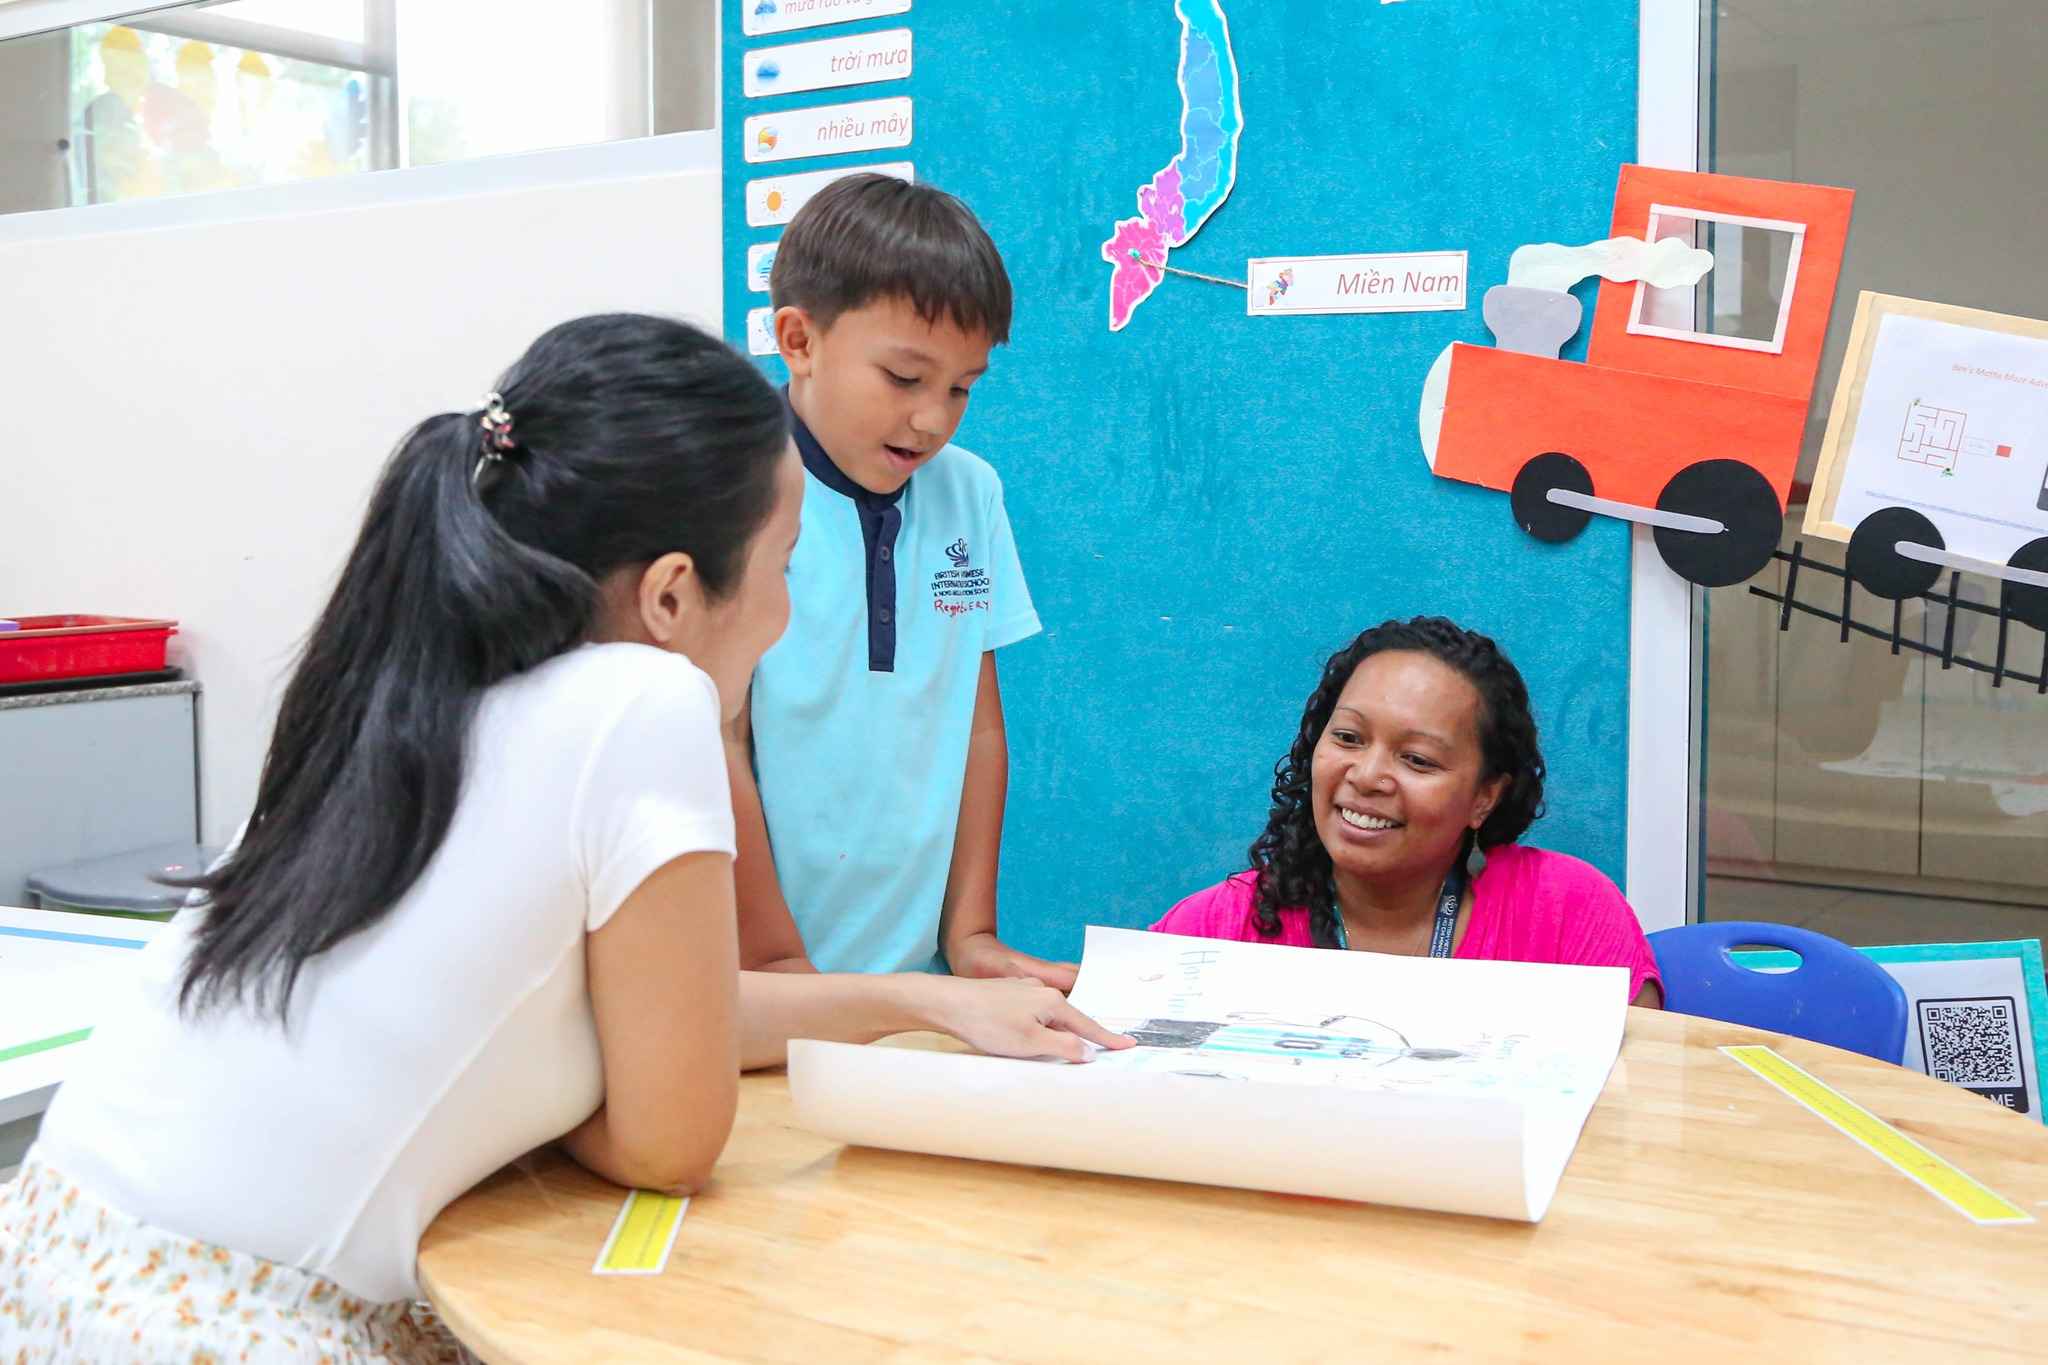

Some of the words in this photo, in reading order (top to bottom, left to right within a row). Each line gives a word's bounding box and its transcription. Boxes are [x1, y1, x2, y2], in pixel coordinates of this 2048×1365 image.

[831, 50, 861, 73] trời
[866, 48, 908, 68] mưa
[816, 116, 865, 141] nhiều
[870, 113, 909, 136] mây
[1336, 268, 1395, 295] Miền
[1402, 270, 1460, 294] Nam
[1990, 1093, 2016, 1107] ME
